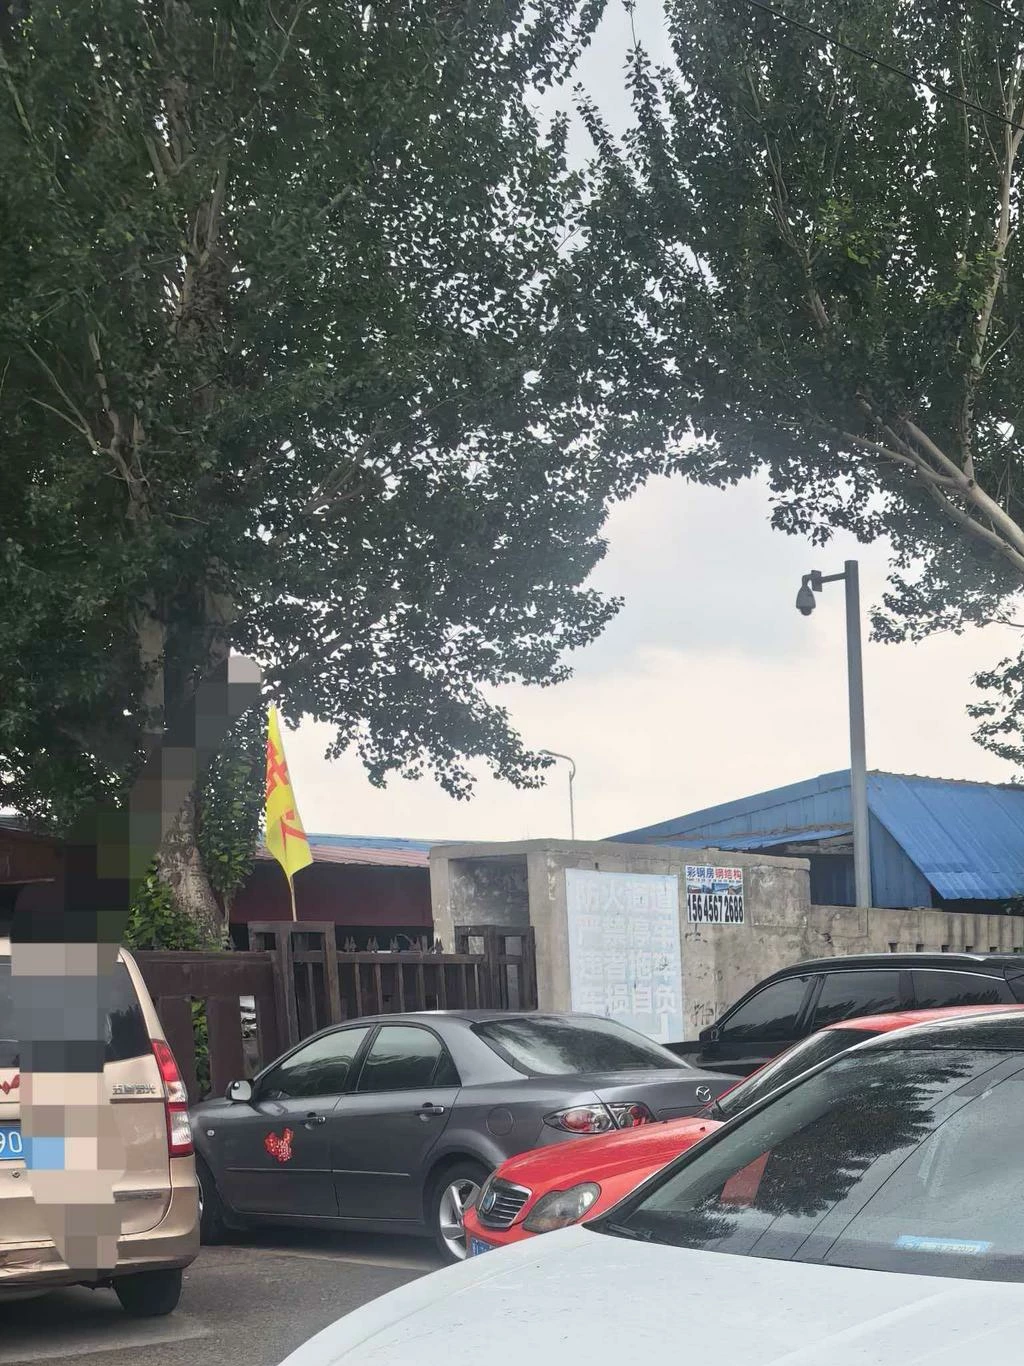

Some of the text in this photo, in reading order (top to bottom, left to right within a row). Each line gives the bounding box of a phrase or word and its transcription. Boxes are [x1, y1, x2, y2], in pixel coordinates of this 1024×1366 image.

[687, 894, 743, 922] 156 4567 2688
